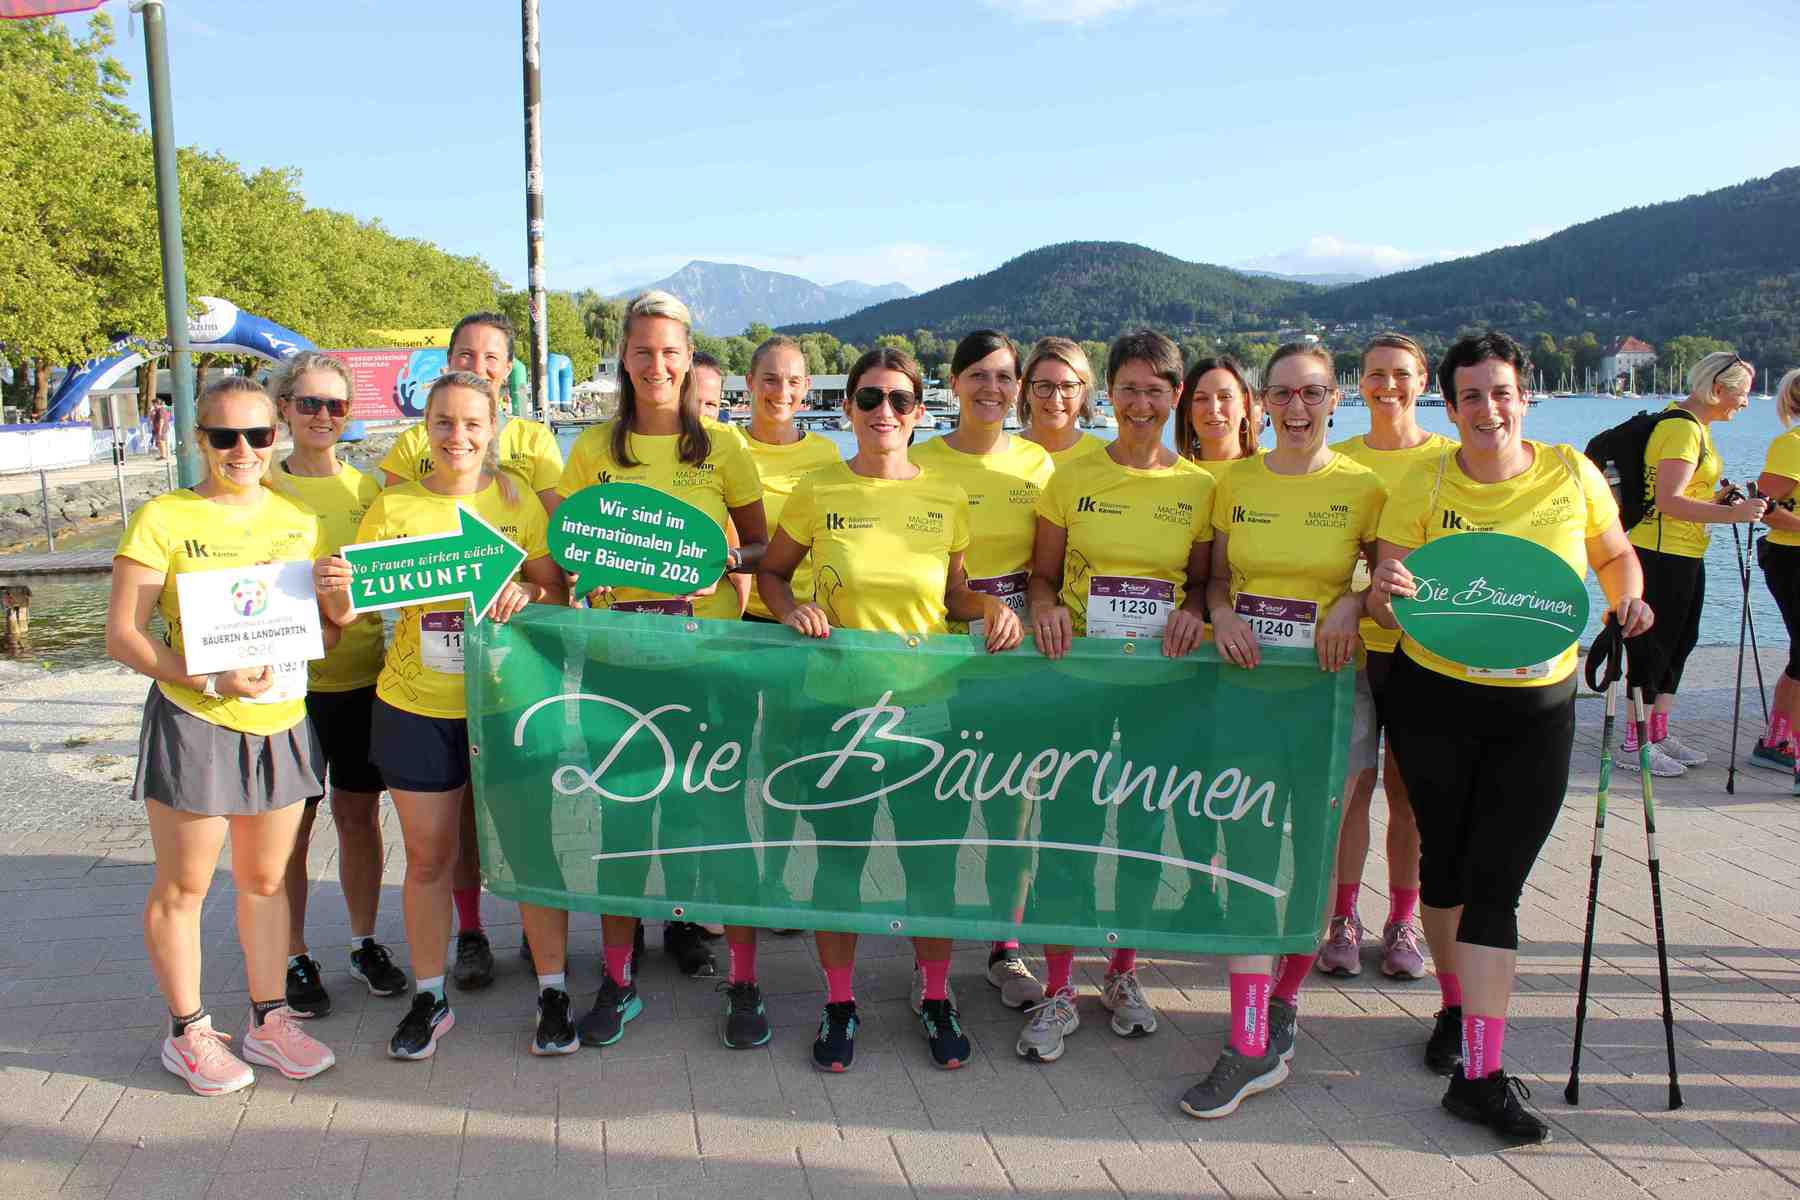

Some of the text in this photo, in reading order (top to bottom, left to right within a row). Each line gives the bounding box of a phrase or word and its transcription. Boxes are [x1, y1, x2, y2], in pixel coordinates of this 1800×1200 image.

[599, 497, 685, 530] Wir sind im
[1329, 504, 1349, 513] WIR
[562, 516, 708, 560] internationalen Jahr
[372, 558, 415, 573] Frauen
[419, 550, 461, 565] wirken
[463, 543, 505, 559] wächst
[564, 543, 700, 585] der Bäuerin 2026
[361, 562, 484, 597] ZUKUNFT
[1411, 575, 1449, 602] Die
[1109, 598, 1157, 616] 11230
[243, 631, 250, 641] &
[251, 624, 307, 640] LANDWIRTIN
[1247, 618, 1294, 637] 11240
[512, 690, 1277, 828] Die Bäuerinnen
